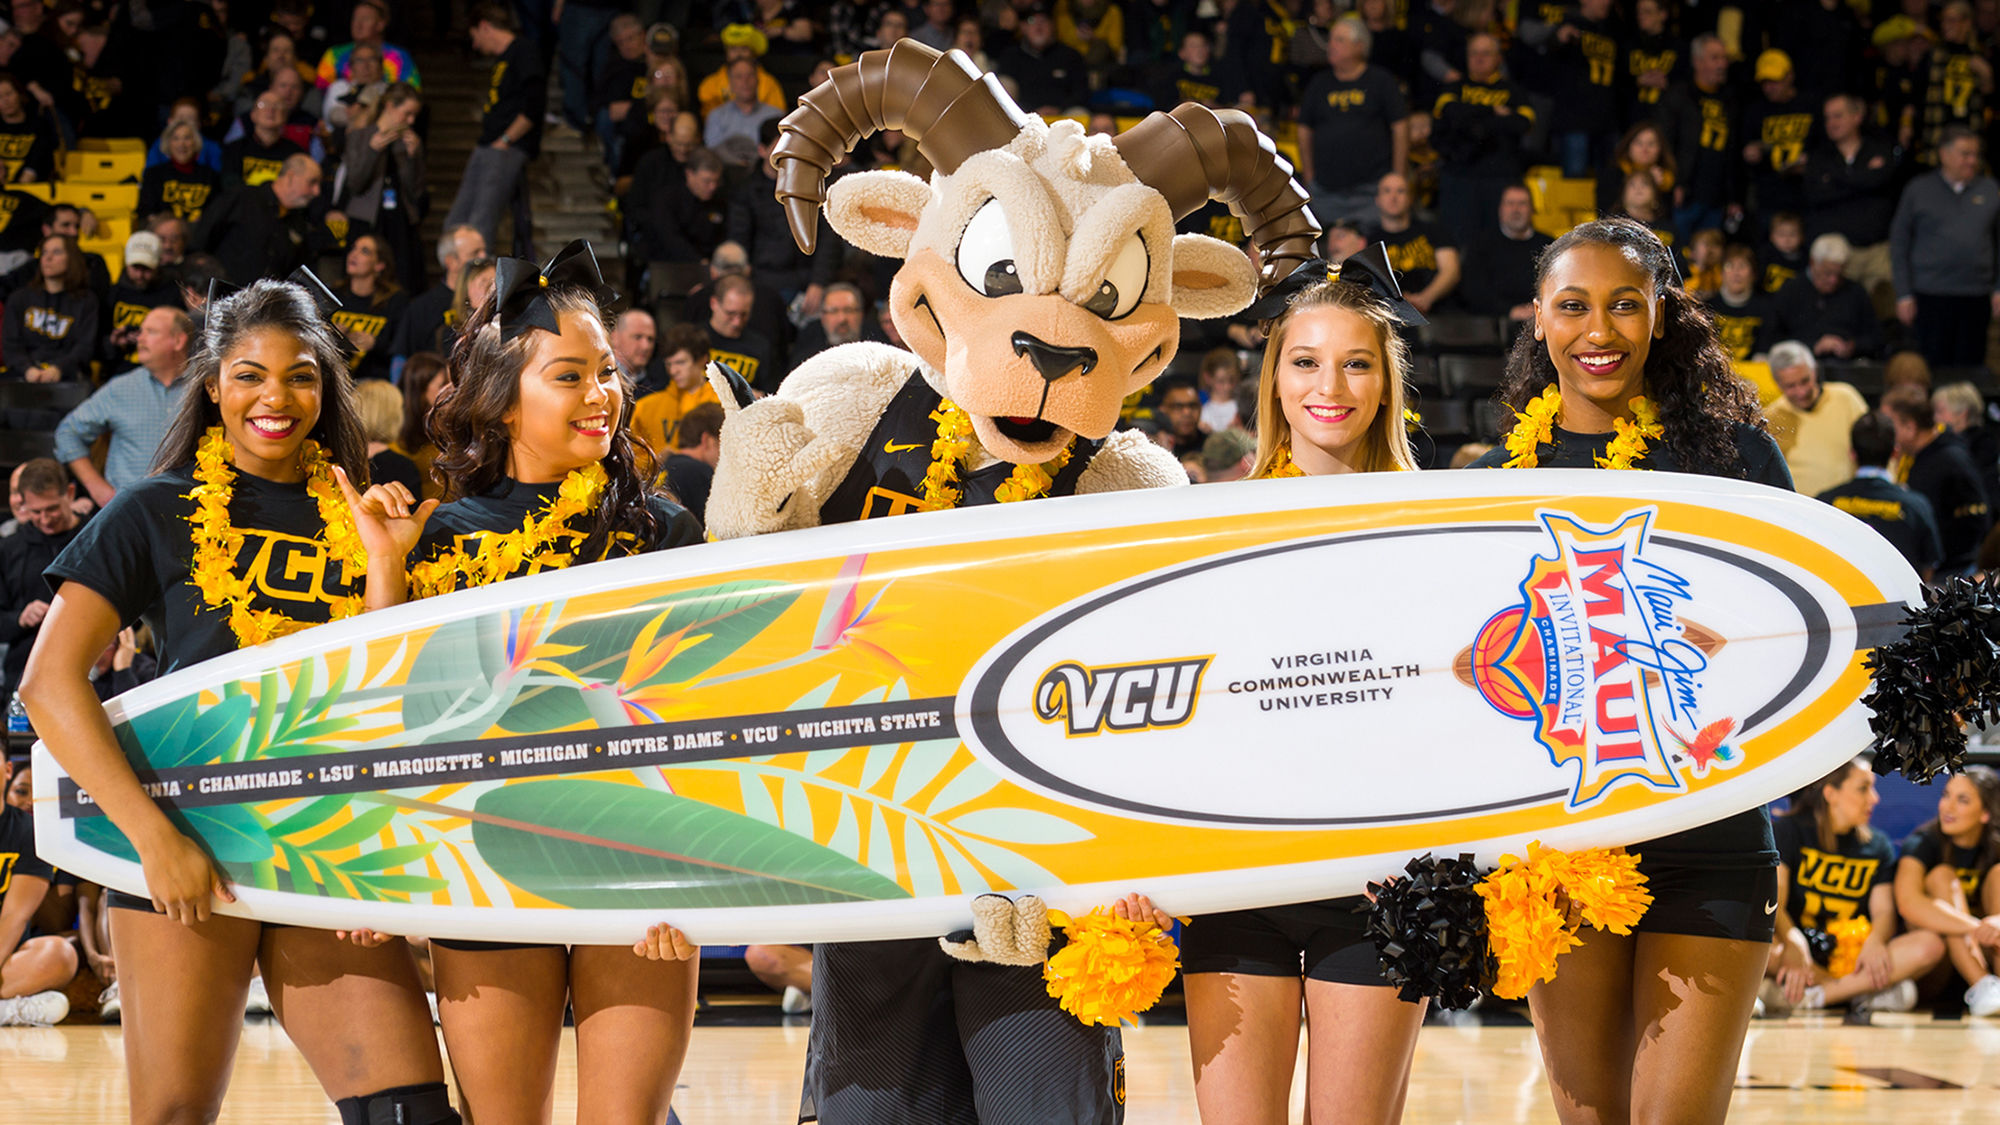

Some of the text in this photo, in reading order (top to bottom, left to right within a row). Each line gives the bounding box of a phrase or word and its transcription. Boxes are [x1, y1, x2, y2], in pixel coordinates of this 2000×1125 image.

[1632, 558, 1693, 631] Maui
[1228, 664, 1420, 693] COMMONWEALTH
[1271, 649, 1373, 669] VIRGINIA
[1541, 619, 1557, 700] CHAMINADE
[1549, 593, 1585, 724] INVITATIONAL
[1571, 542, 1647, 766] MAUI
[1034, 656, 1213, 737] VCU
[1259, 687, 1393, 711] UNIVERSITY
[199, 769, 303, 794] CHAMINADE
[319, 764, 355, 783] LSU
[372, 753, 484, 778] MARQUETTE
[500, 743, 589, 766] MICHIGAN
[607, 735, 669, 756] NOTRE
[673, 731, 725, 750] DAME
[742, 725, 780, 744] VCU
[797, 716, 876, 739] WICHITA
[880, 710, 941, 731] STATE
[1797, 847, 1880, 898] VCU
